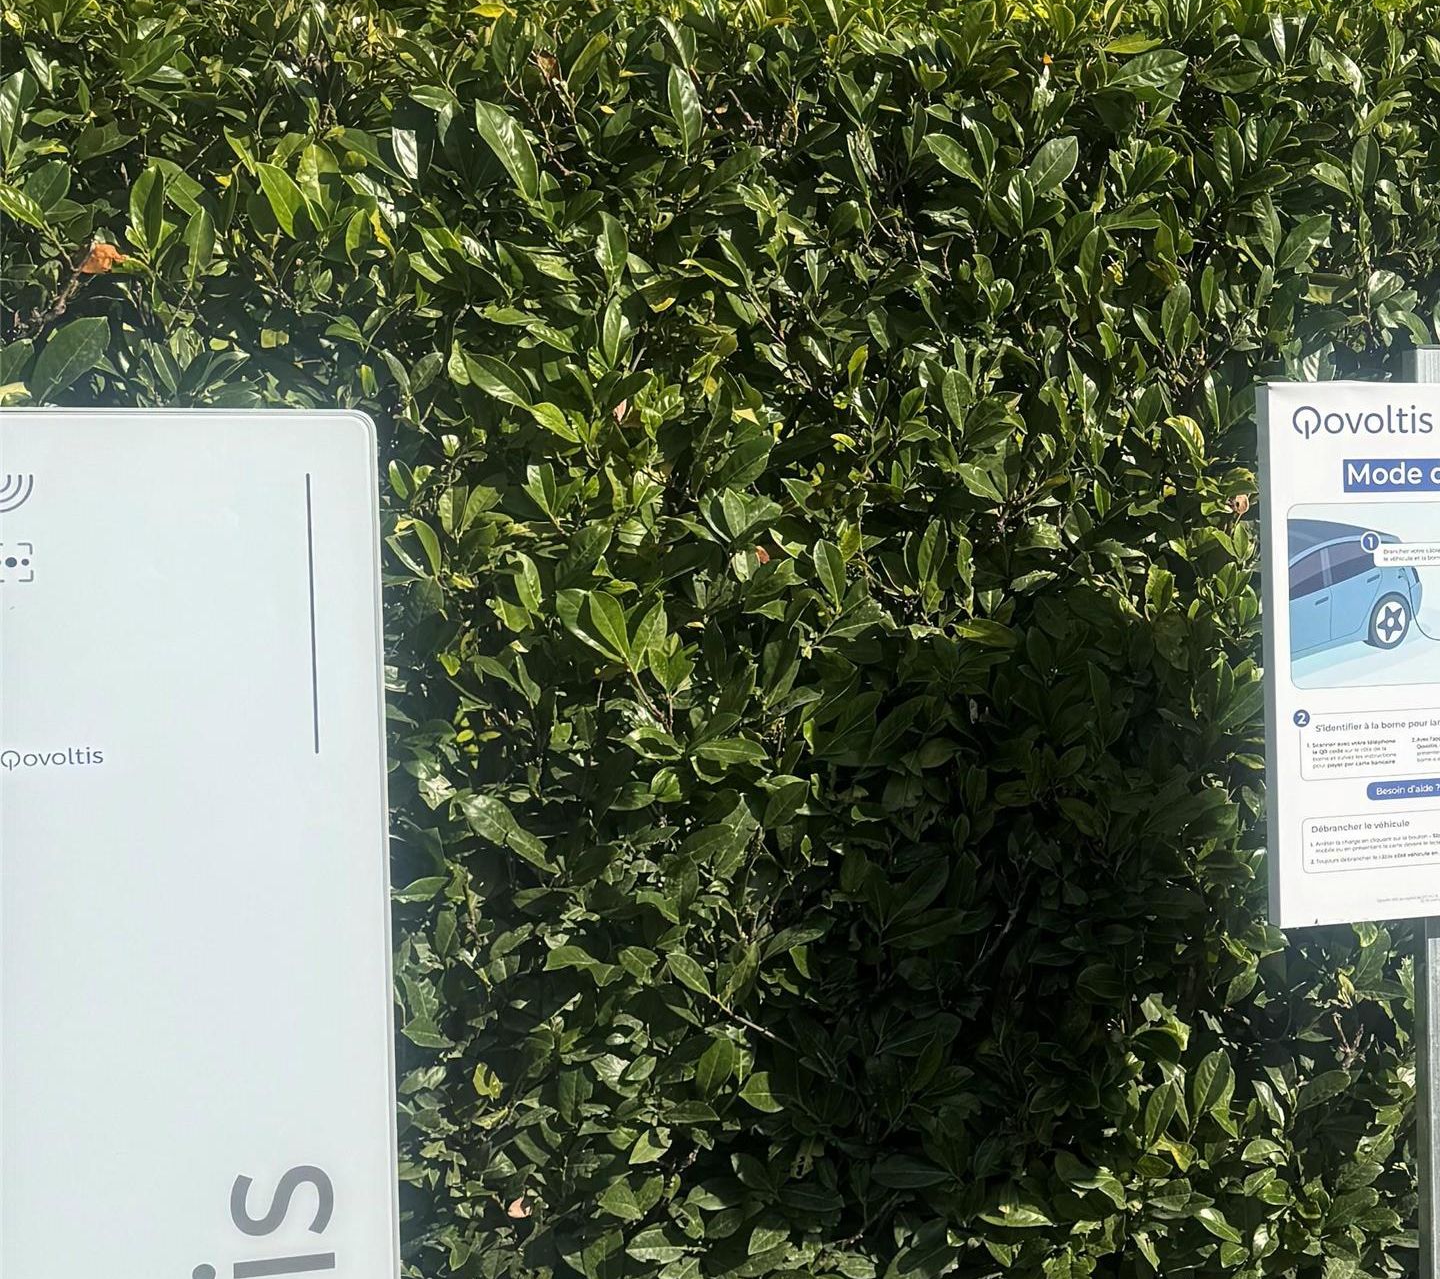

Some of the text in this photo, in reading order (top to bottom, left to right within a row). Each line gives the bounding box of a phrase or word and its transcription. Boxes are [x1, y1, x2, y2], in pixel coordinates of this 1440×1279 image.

[1292, 404, 1434, 439] Qovoltis
[1347, 461, 1423, 486] Mode
[1367, 536, 1374, 549] 1
[1296, 712, 1306, 725] 2
[1316, 723, 1362, 733] S'identifier
[1364, 722, 1370, 730] à
[1371, 722, 1379, 730] la
[1381, 721, 1406, 730] borne
[1408, 720, 1428, 729] pour
[0, 746, 104, 771] Qovoltis
[1376, 783, 1440, 796] Besoin d'aide ?
[1311, 819, 1410, 834] Débrancher le véhicule
